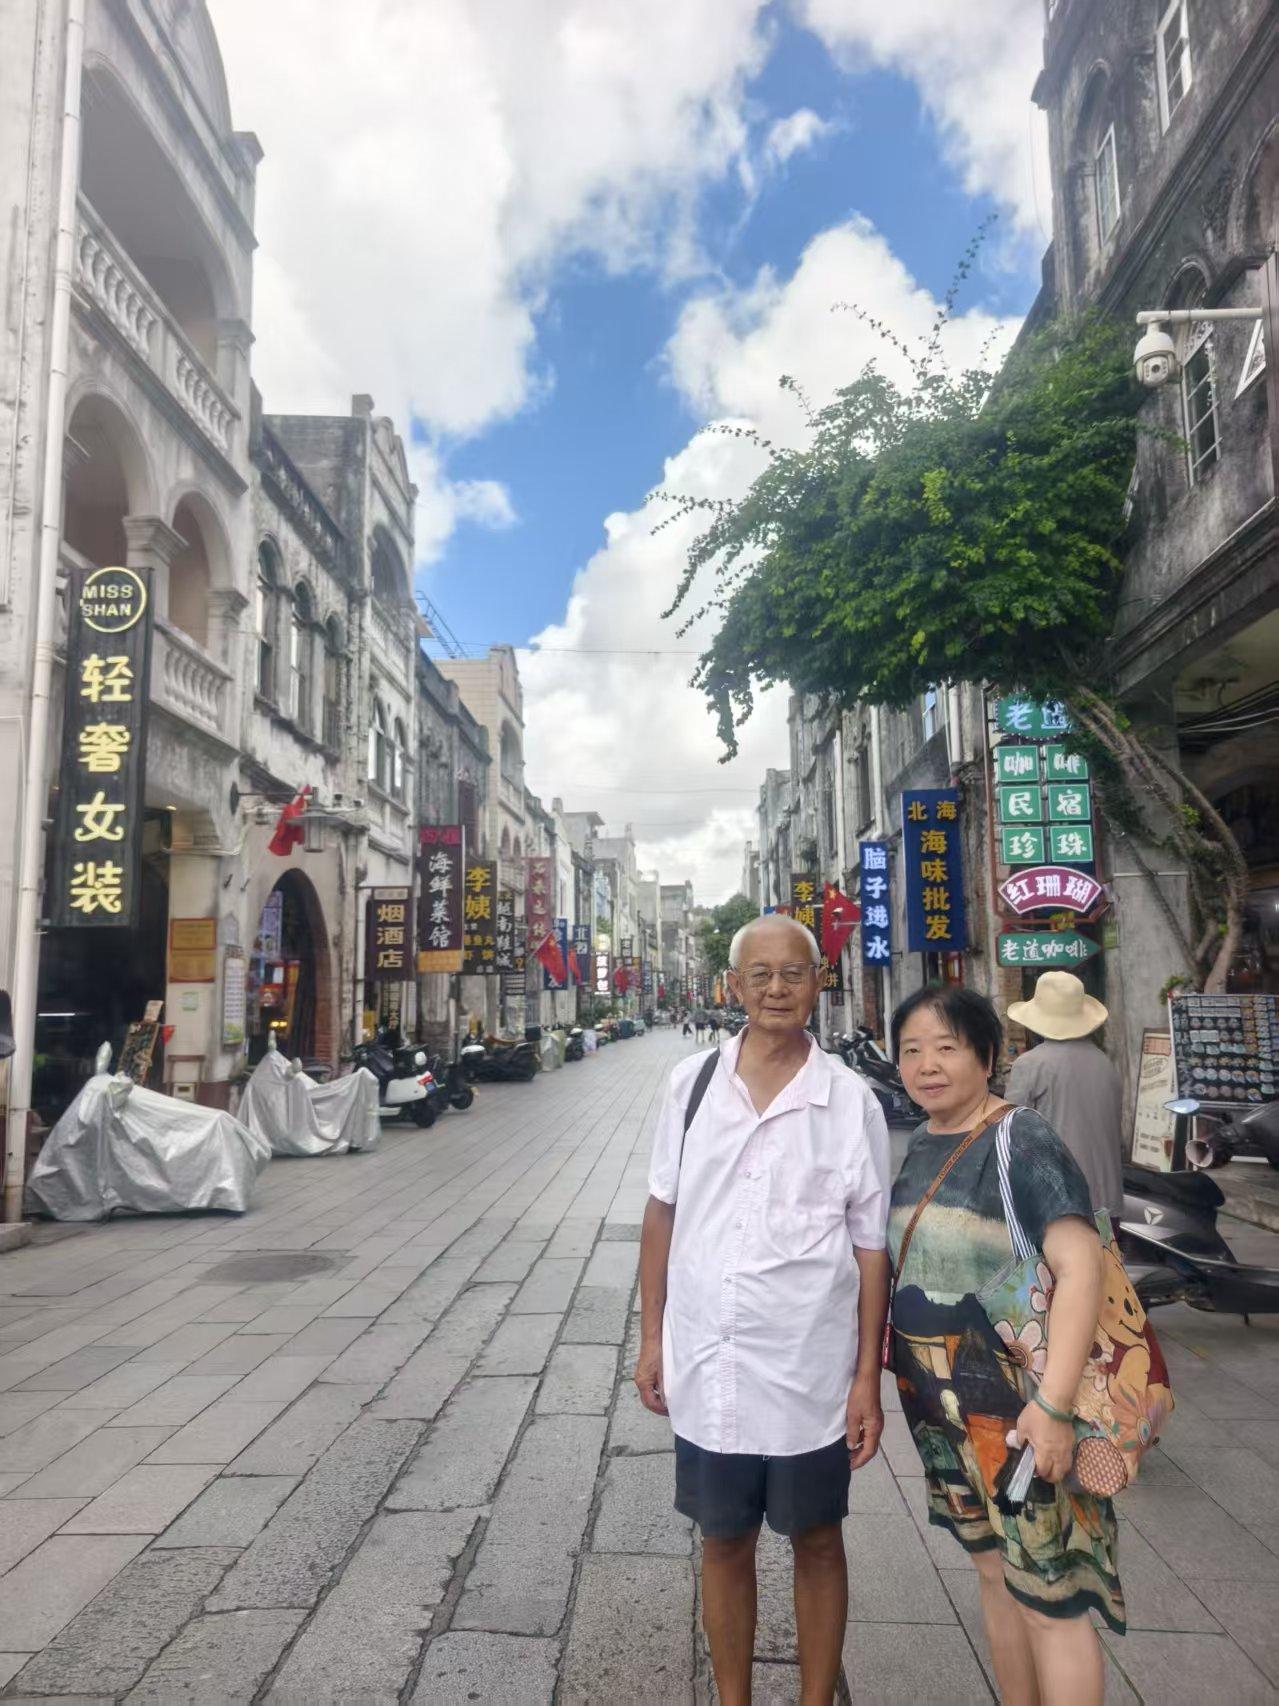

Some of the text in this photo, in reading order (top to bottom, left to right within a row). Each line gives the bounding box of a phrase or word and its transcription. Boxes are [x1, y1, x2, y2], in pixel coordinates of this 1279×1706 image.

[82, 585, 134, 599] MISS
[81, 603, 132, 618] SHAN
[1004, 752, 1080, 776] 咖啡
[70, 653, 135, 915] 轻奢女装
[908, 800, 958, 822] 北海
[1008, 788, 1083, 817] 民宿
[1009, 832, 1087, 860] 珍珠
[428, 851, 454, 949] 海鲜菜馆
[465, 865, 492, 921] 李姨
[921, 829, 951, 941] 海味批发
[1007, 873, 1093, 906] 红珊瑚
[863, 847, 890, 960] 脑子进水
[376, 903, 406, 968] 烟酒店
[1002, 938, 1089, 962] 老道咖啡
